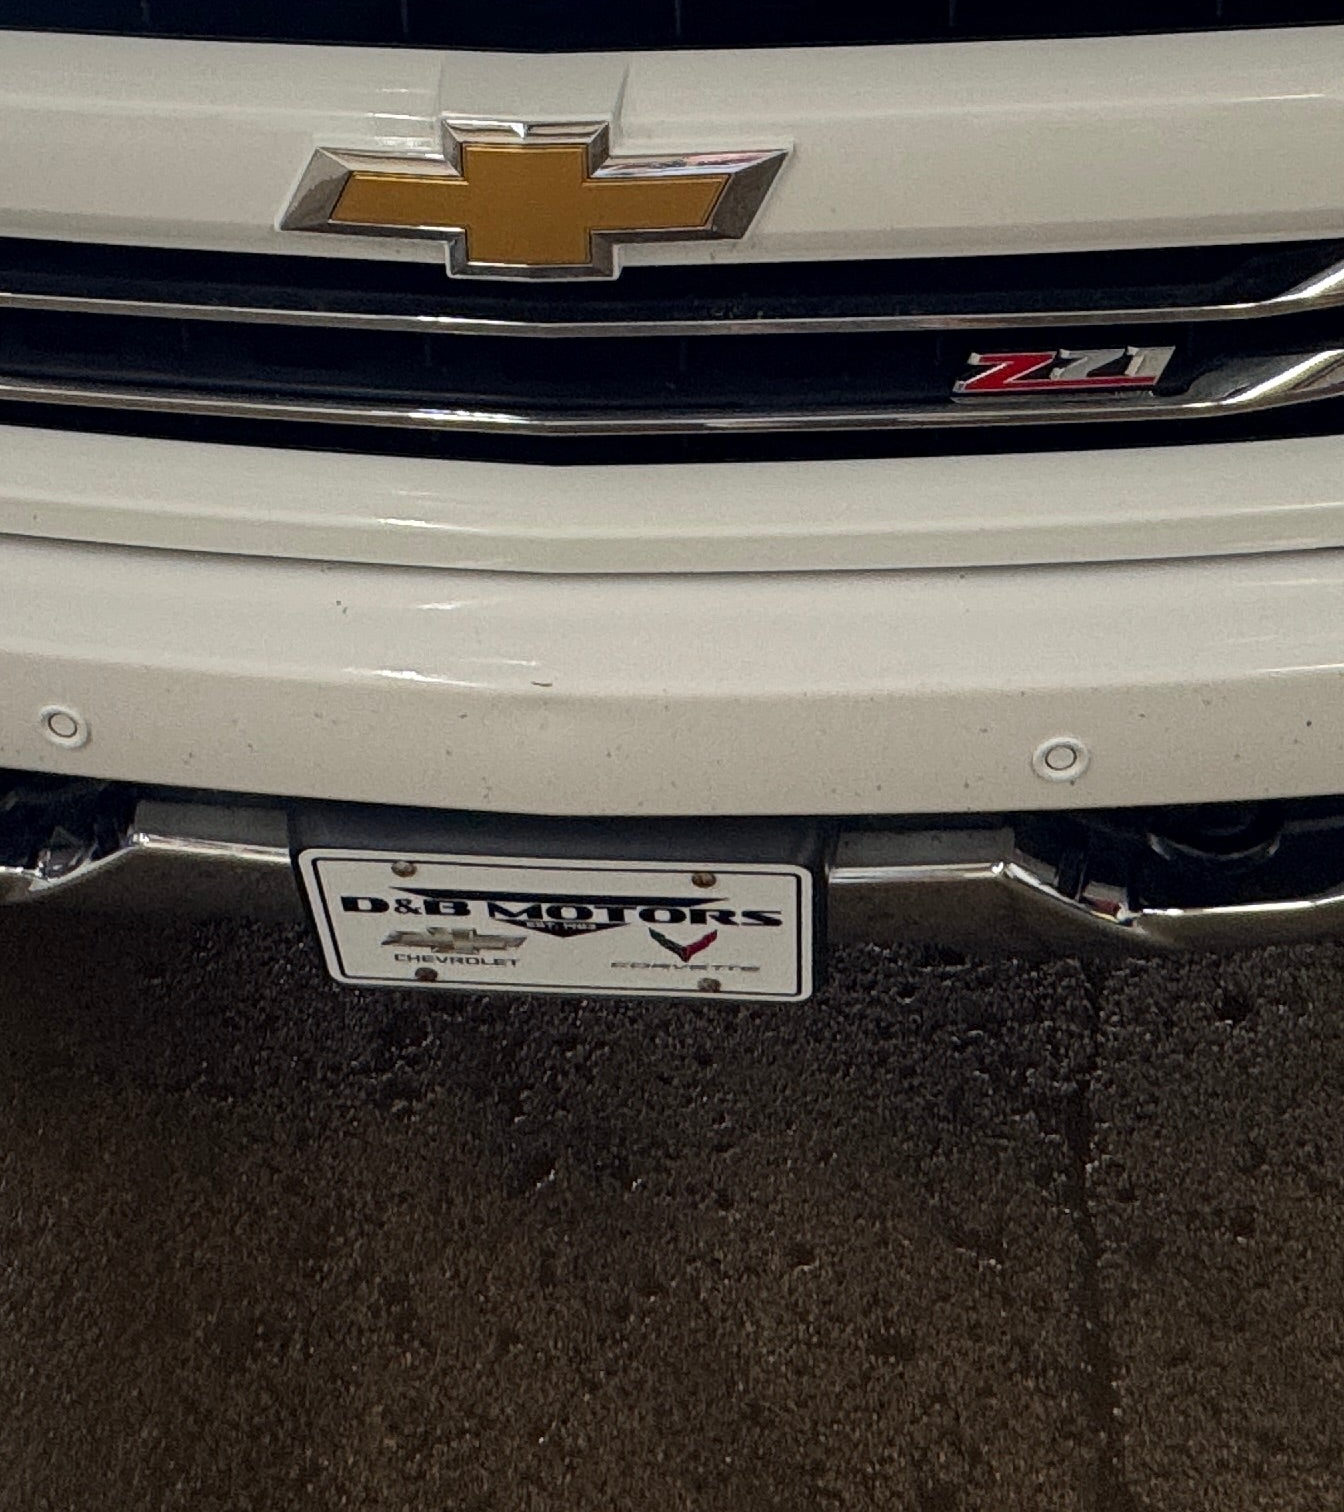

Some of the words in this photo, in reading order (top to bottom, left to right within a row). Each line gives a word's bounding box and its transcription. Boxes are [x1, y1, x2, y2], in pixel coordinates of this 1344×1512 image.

[953, 345, 1176, 392] Z71
[340, 896, 472, 917] D&B
[487, 901, 783, 927] MOTORS
[394, 953, 517, 966] CHEVROLET
